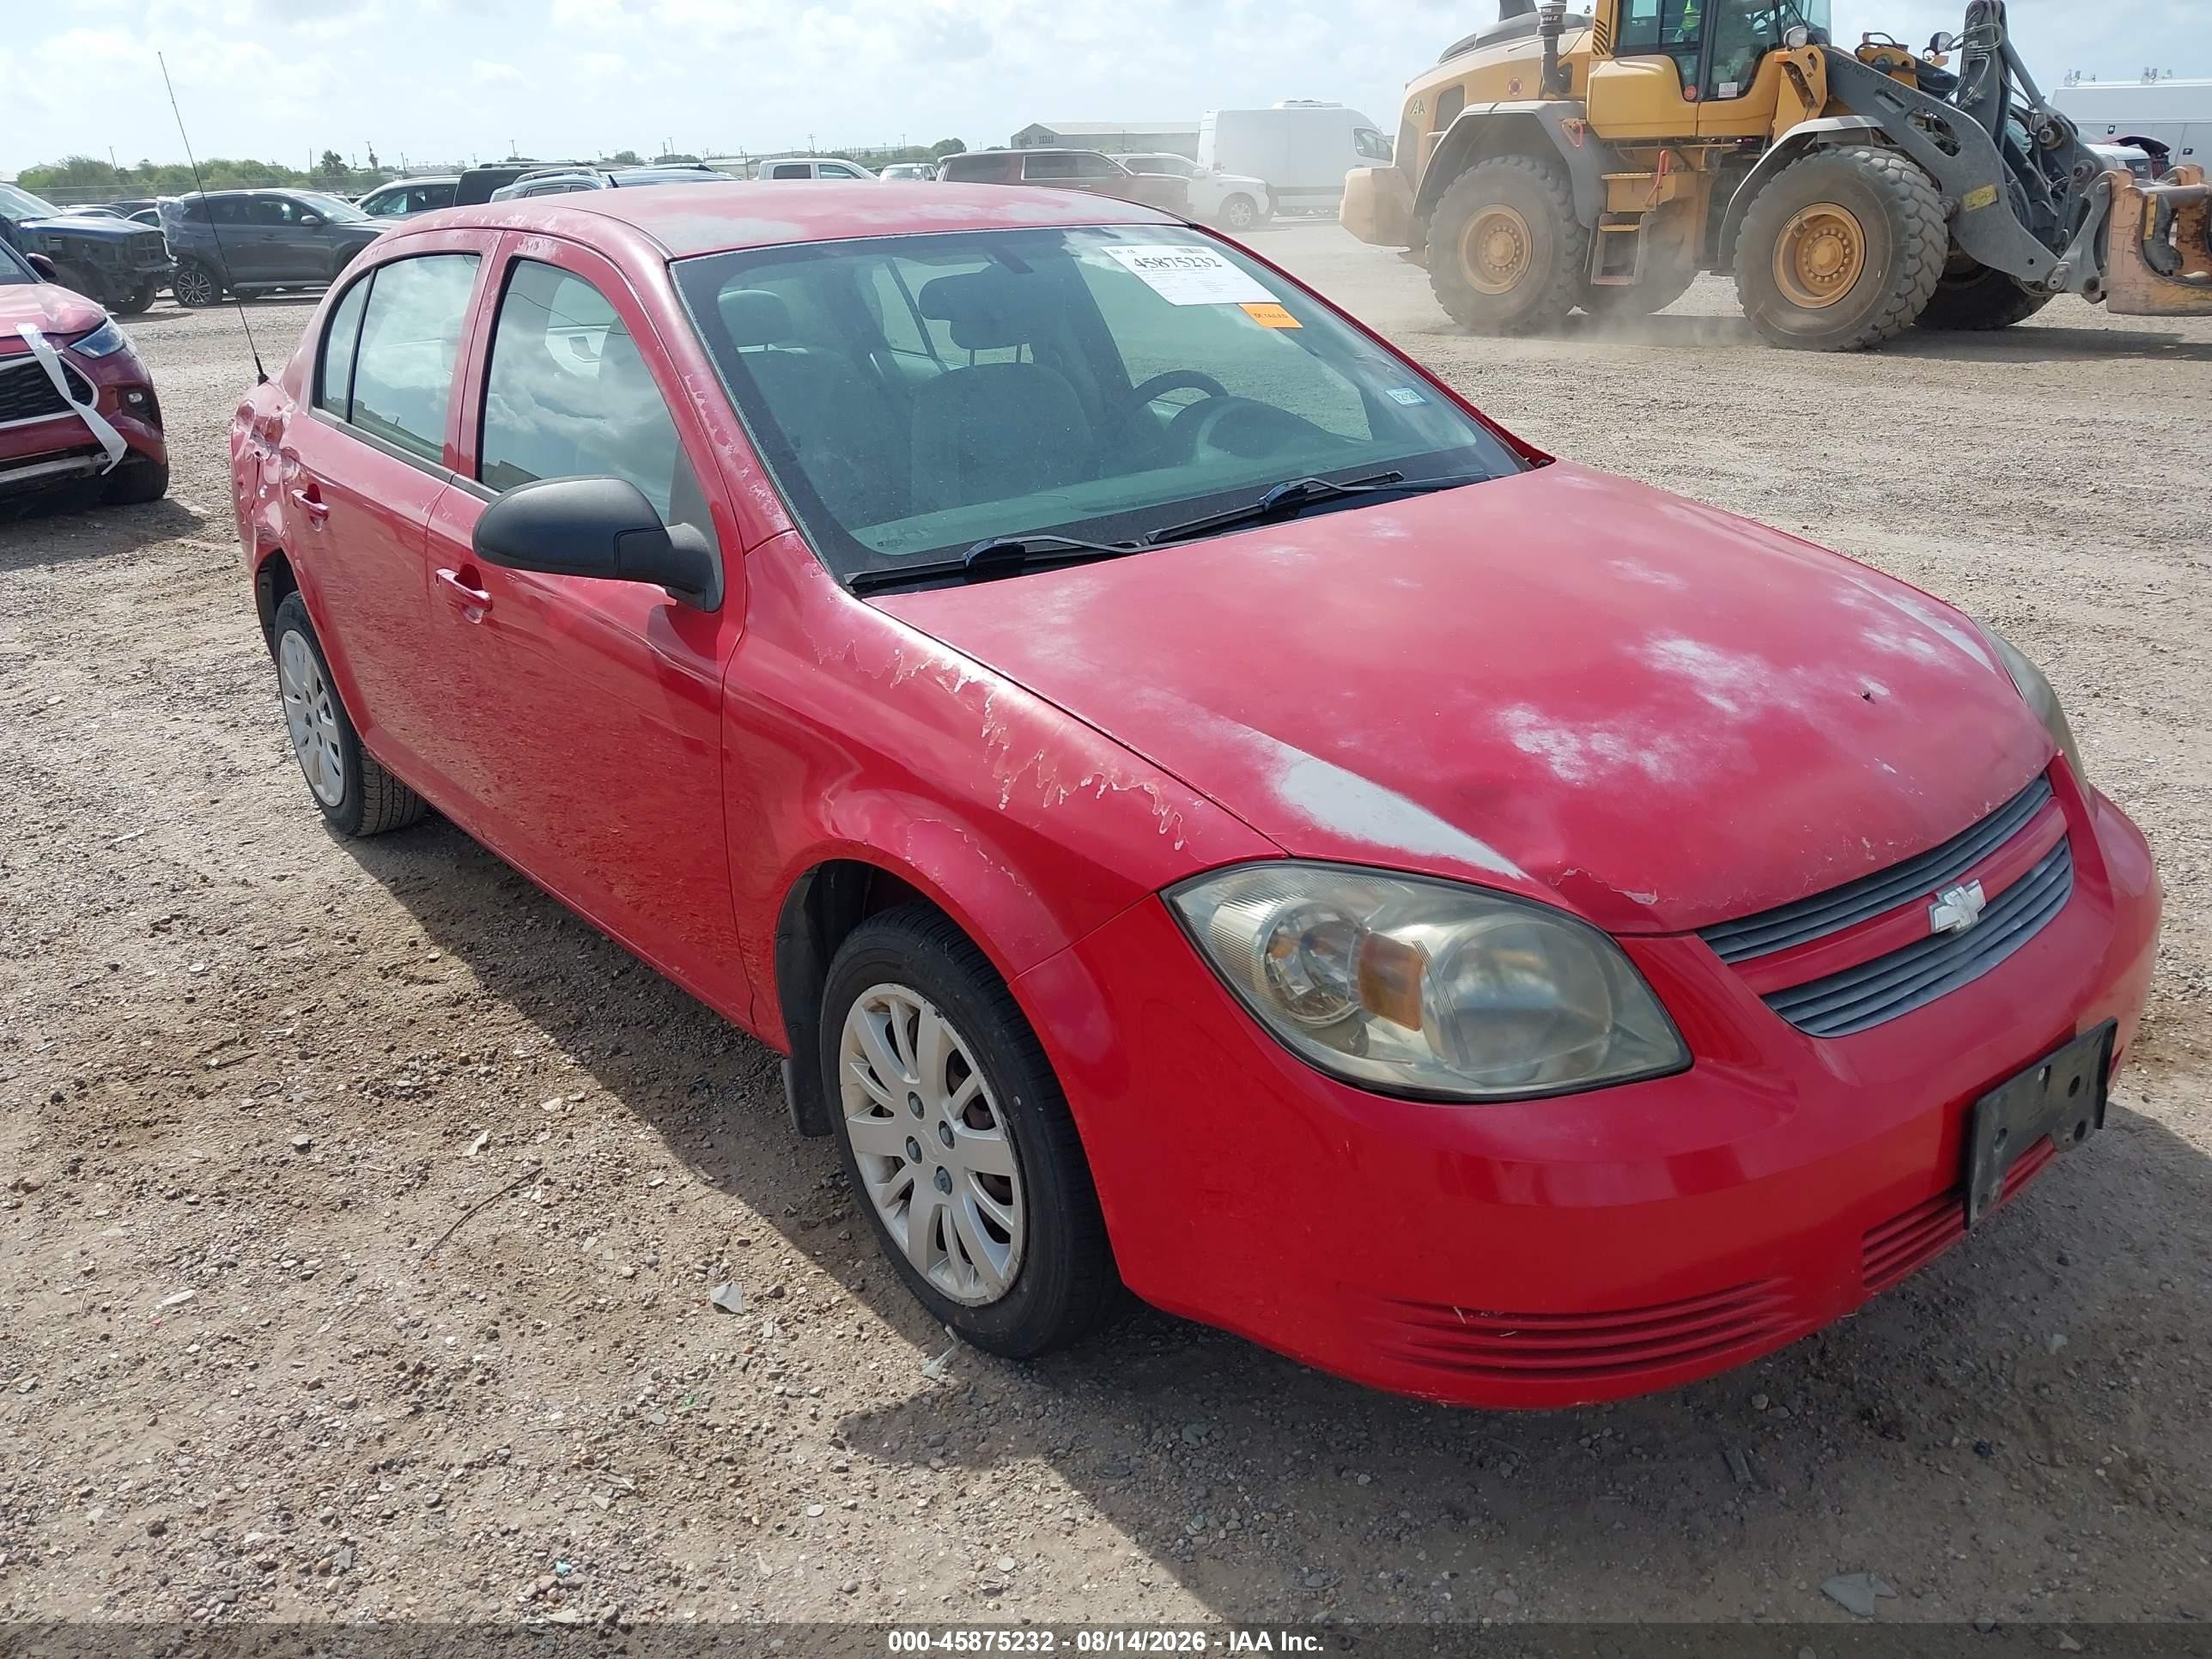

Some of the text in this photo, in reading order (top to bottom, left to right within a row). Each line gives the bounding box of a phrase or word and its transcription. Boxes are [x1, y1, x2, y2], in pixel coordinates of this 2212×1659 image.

[1836, 58, 1851, 70] DO
[1854, 65, 1876, 79] NOT
[1133, 257, 1223, 268] 45875232
